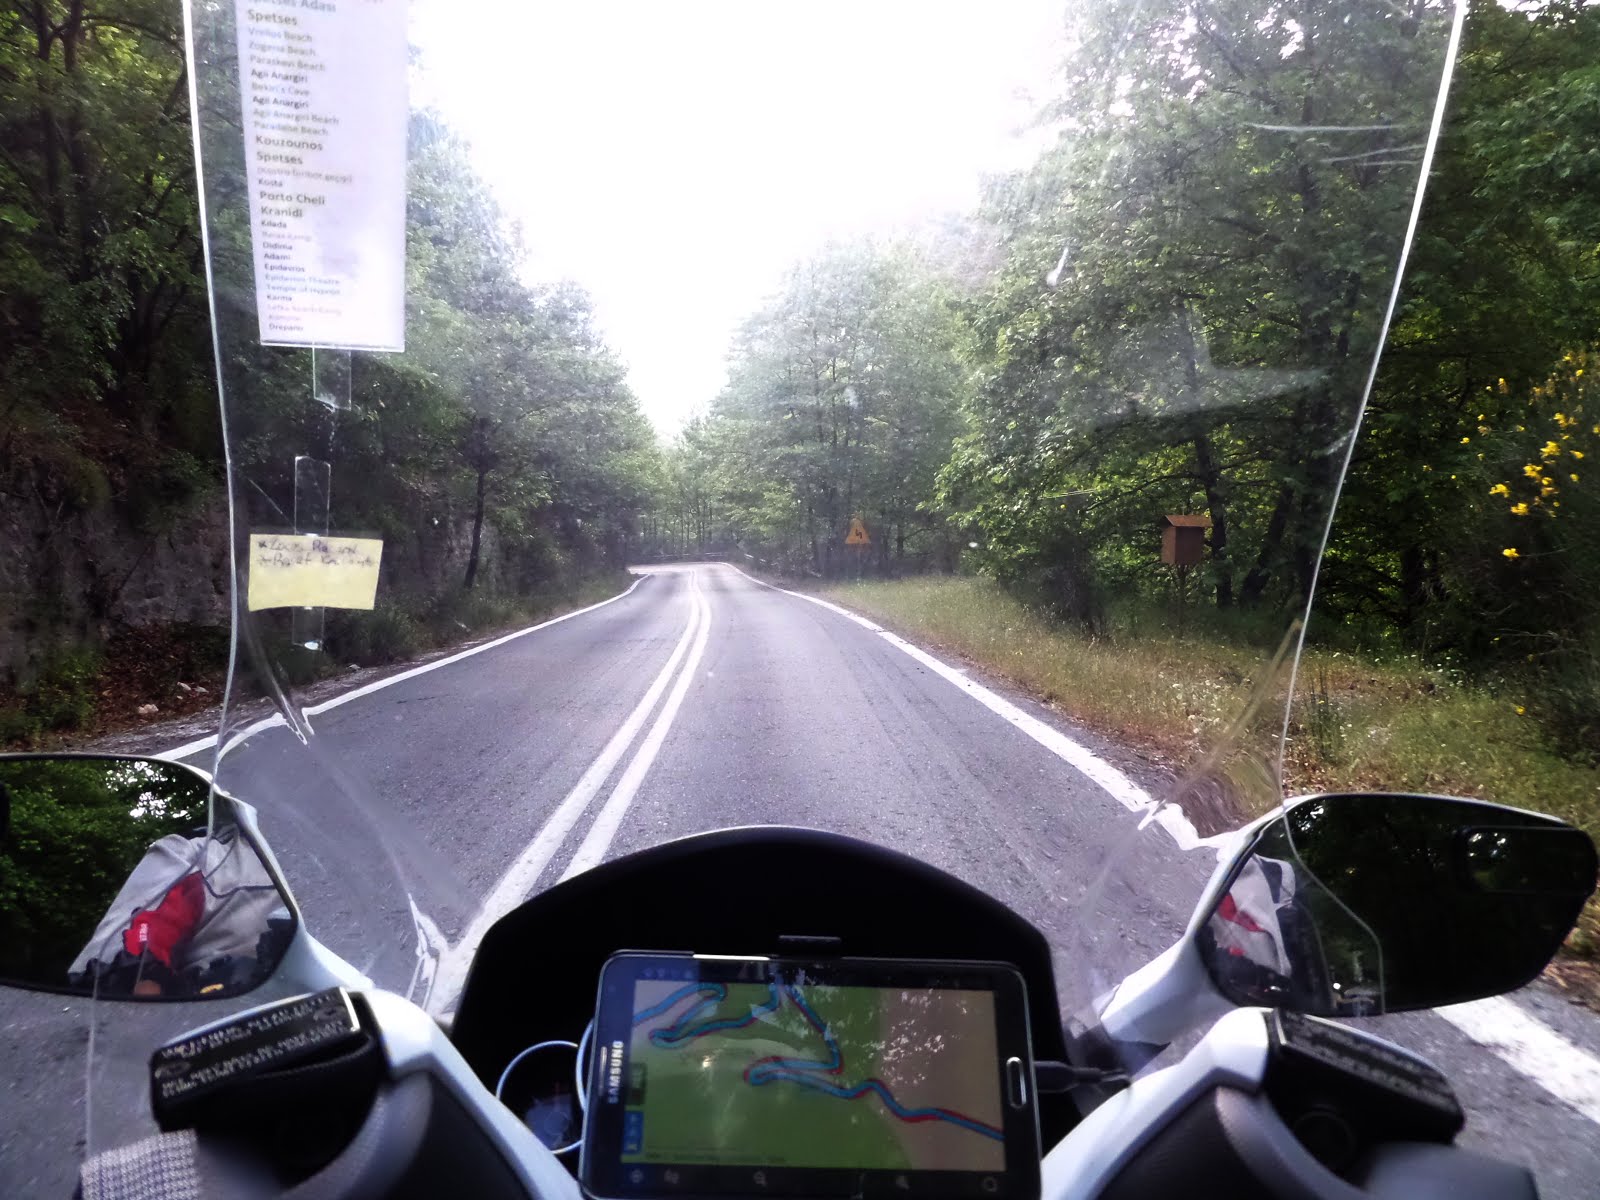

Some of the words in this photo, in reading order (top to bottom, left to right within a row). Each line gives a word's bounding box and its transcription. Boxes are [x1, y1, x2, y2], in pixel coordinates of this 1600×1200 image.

[248, 9, 298, 26] Spetses
[271, 71, 308, 84] Anargiri
[272, 97, 309, 109] Anargiri
[256, 152, 304, 165] Spetses
[260, 191, 293, 203] Porto
[296, 194, 326, 206] Cheli
[261, 206, 303, 219] Kranidi
[264, 252, 292, 262] Adami
[265, 263, 306, 274] Epidavros
[608, 1040, 624, 1104] SAMSUNG
